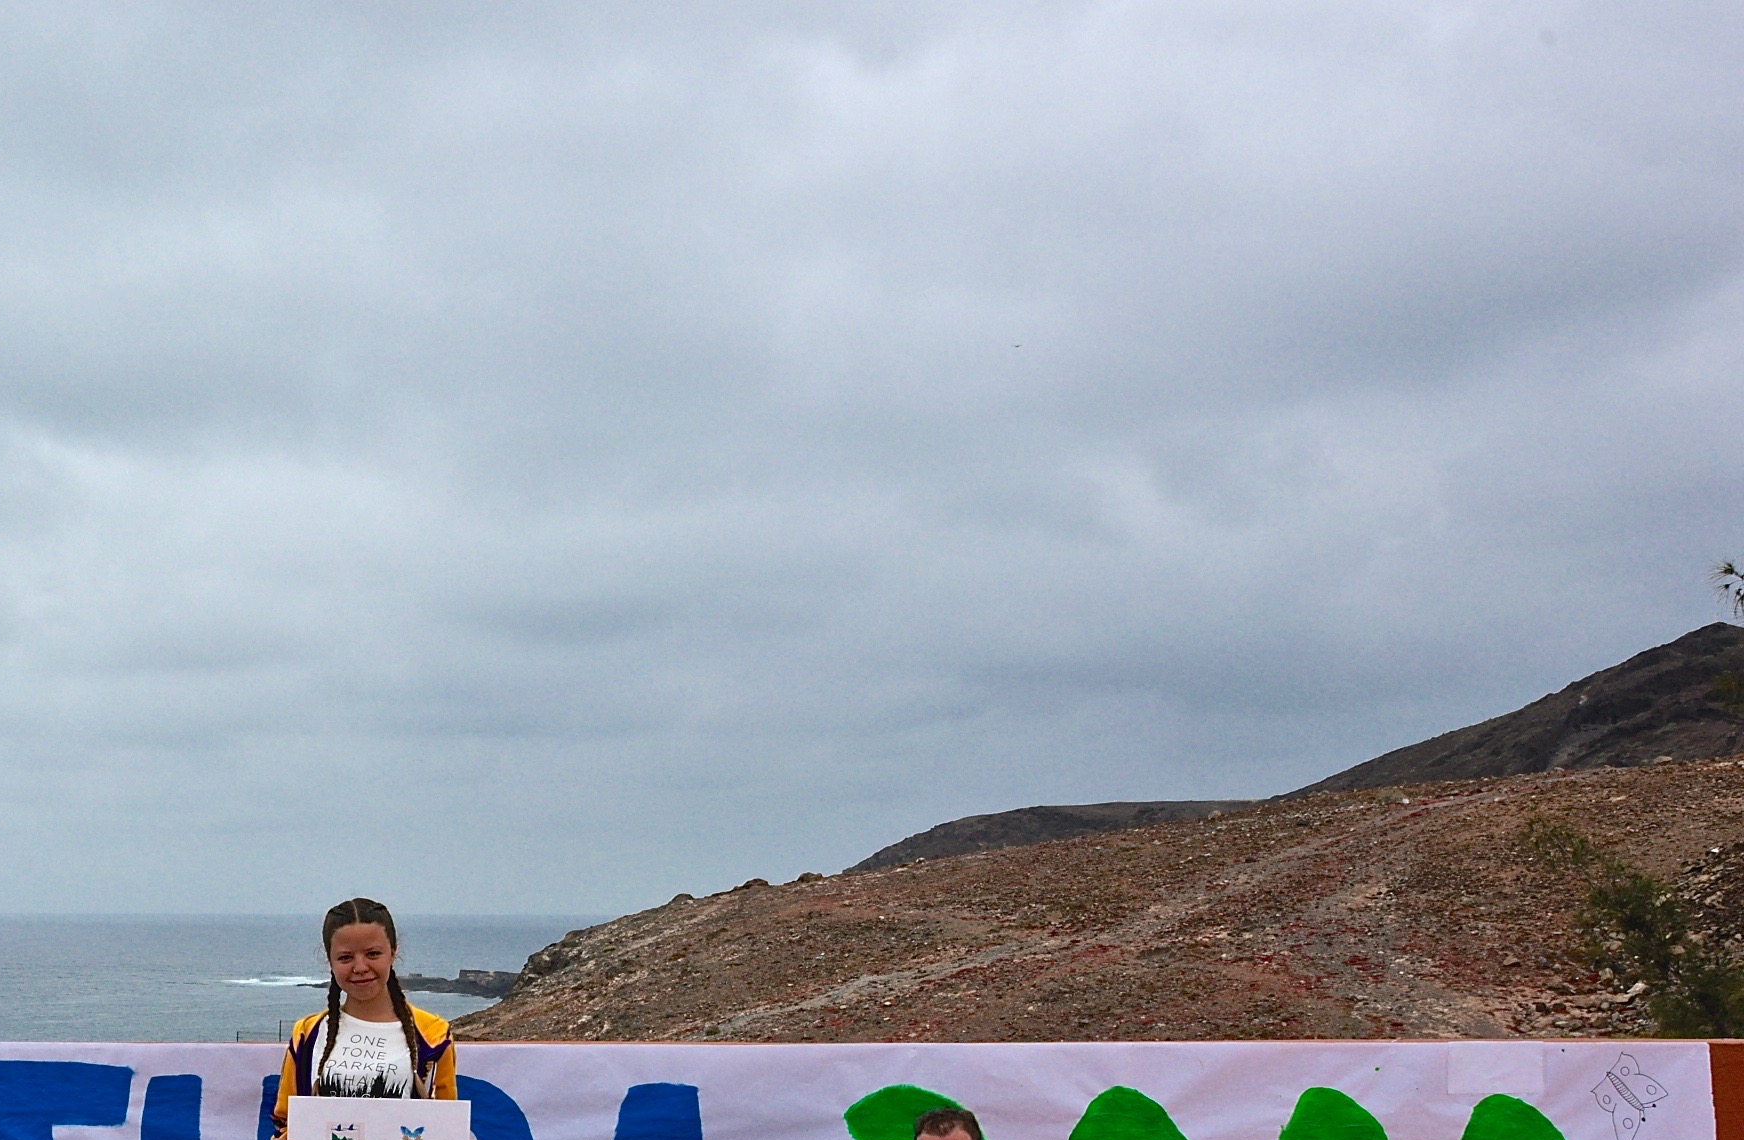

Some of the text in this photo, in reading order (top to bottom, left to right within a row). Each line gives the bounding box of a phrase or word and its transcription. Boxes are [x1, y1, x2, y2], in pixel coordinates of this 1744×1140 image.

[350, 1034, 387, 1048] ONE
[342, 1047, 387, 1061] TONE
[326, 1059, 398, 1075] DARKER
